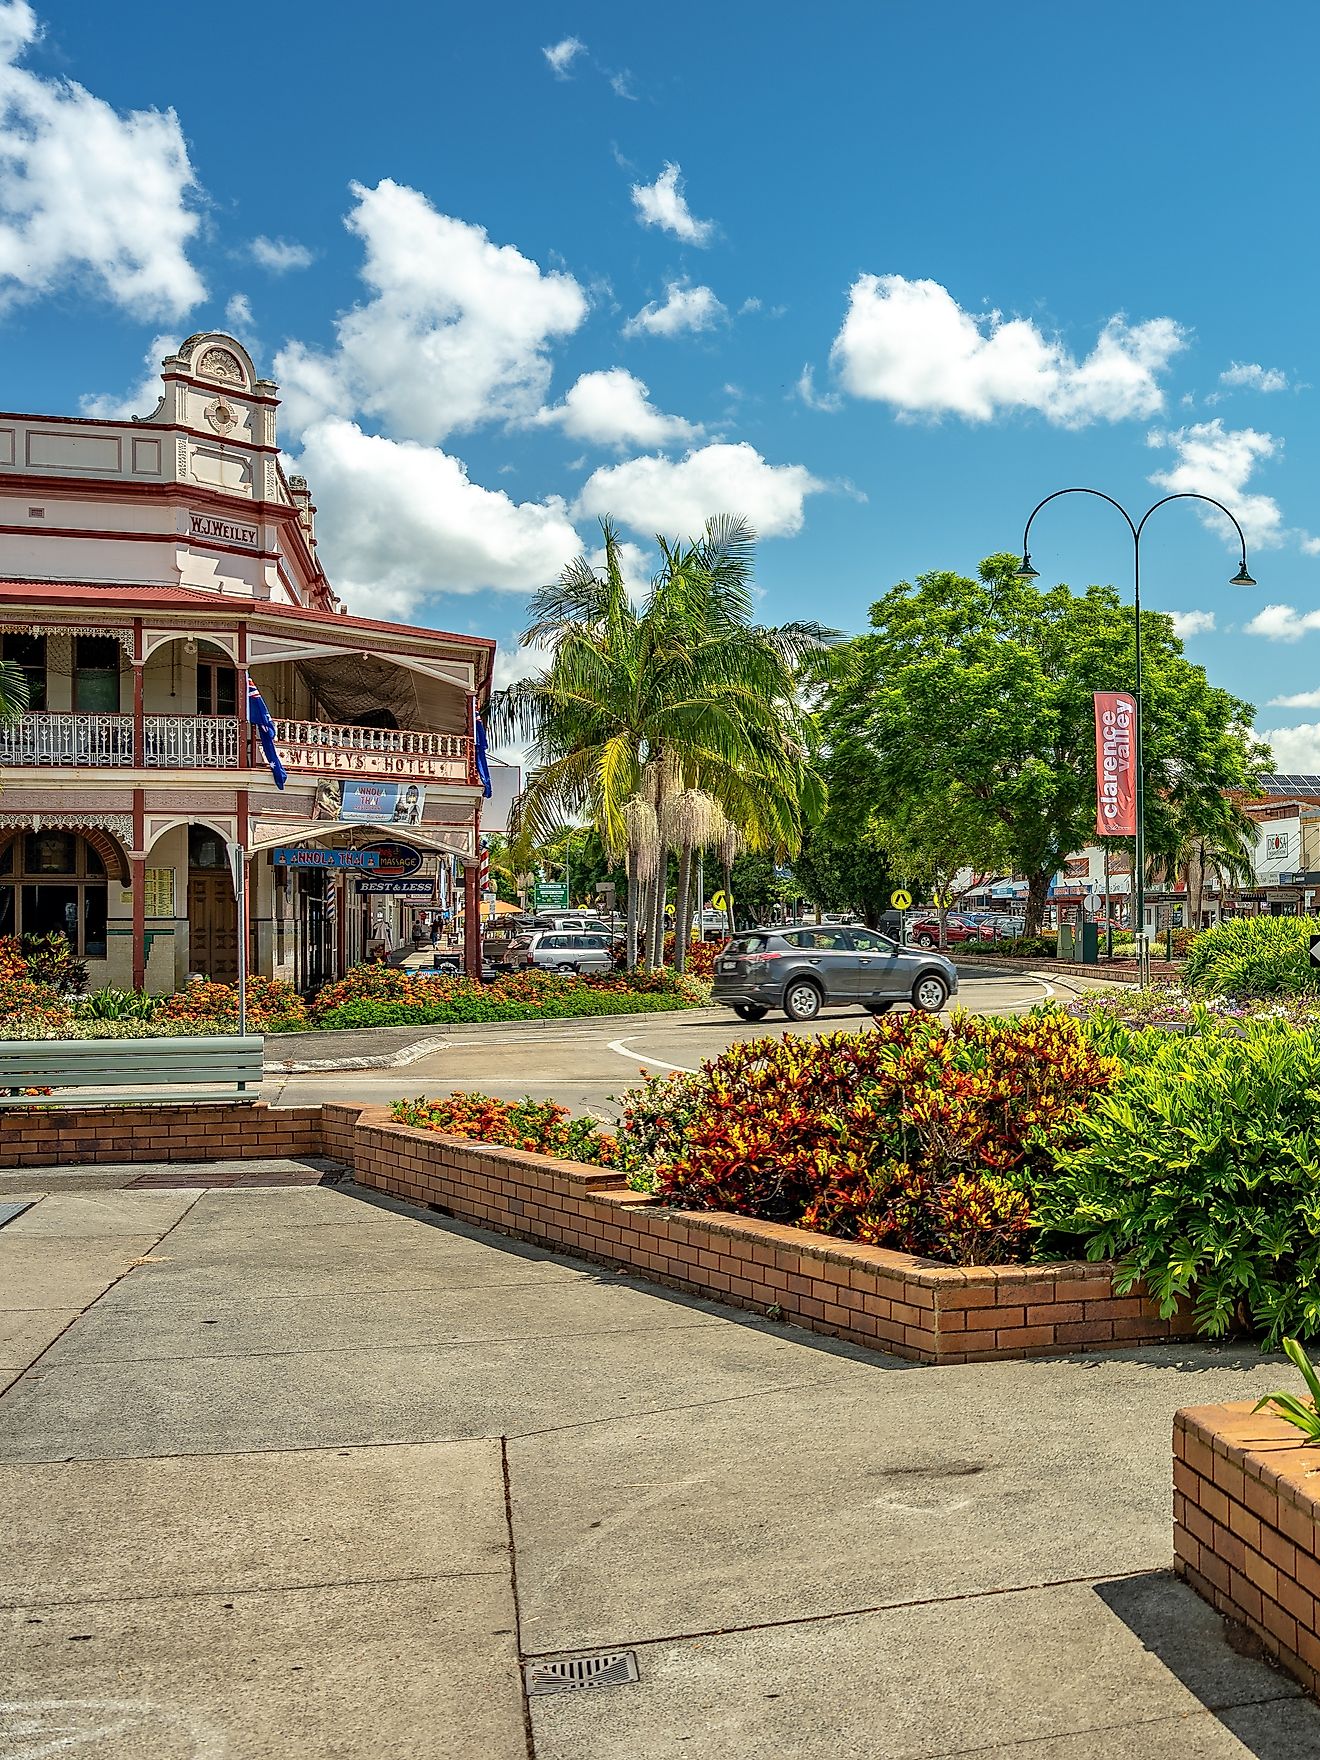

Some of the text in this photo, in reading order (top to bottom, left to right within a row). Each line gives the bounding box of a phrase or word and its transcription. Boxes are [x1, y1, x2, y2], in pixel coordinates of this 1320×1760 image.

[1116, 699, 1134, 772] valley
[384, 758, 435, 775] HOTEL
[1101, 710, 1119, 819] clarence
[360, 796, 379, 805] THAI
[338, 852, 365, 867] THAI
[380, 857, 417, 867] MASSAGE
[360, 882, 433, 892] BEST & LESS
